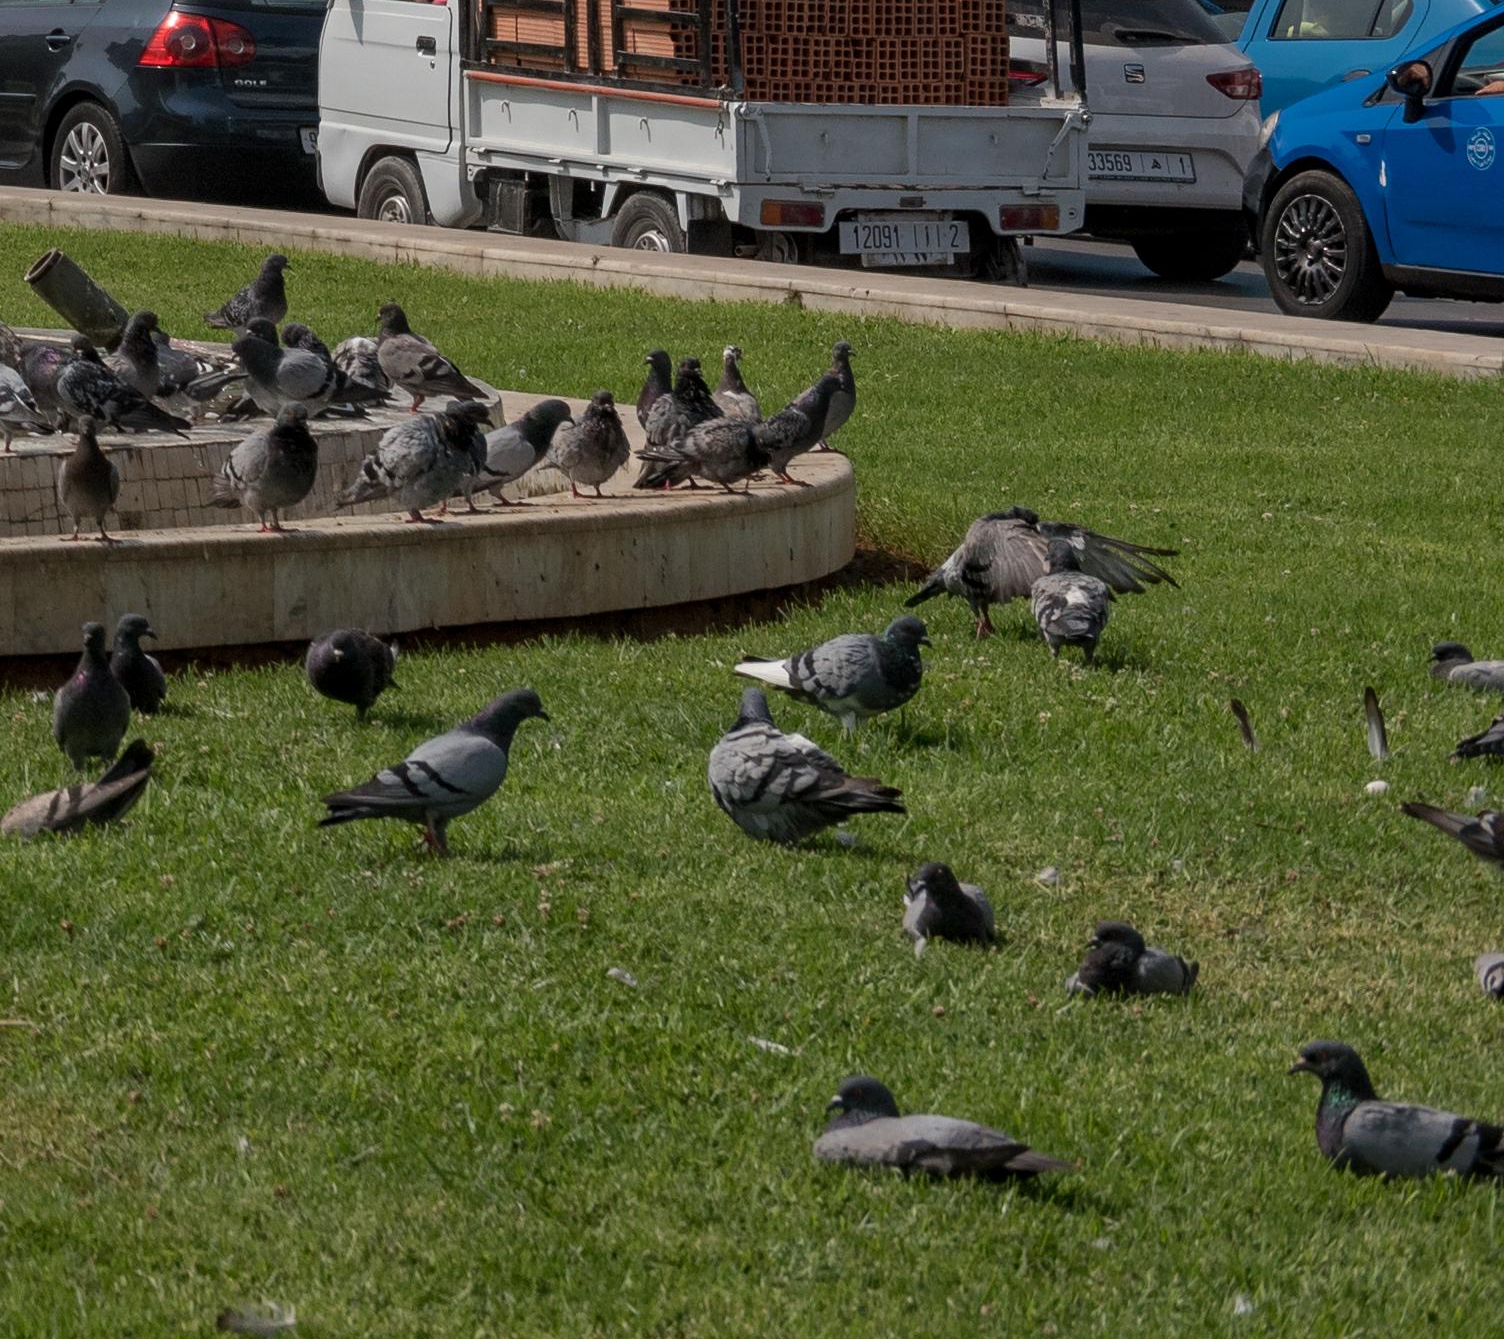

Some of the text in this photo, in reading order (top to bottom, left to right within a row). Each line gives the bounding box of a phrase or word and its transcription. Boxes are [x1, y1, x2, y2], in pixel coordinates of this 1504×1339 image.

[1088, 152, 1133, 172] 33569
[853, 224, 900, 249] 12091
[949, 224, 959, 248] 2
